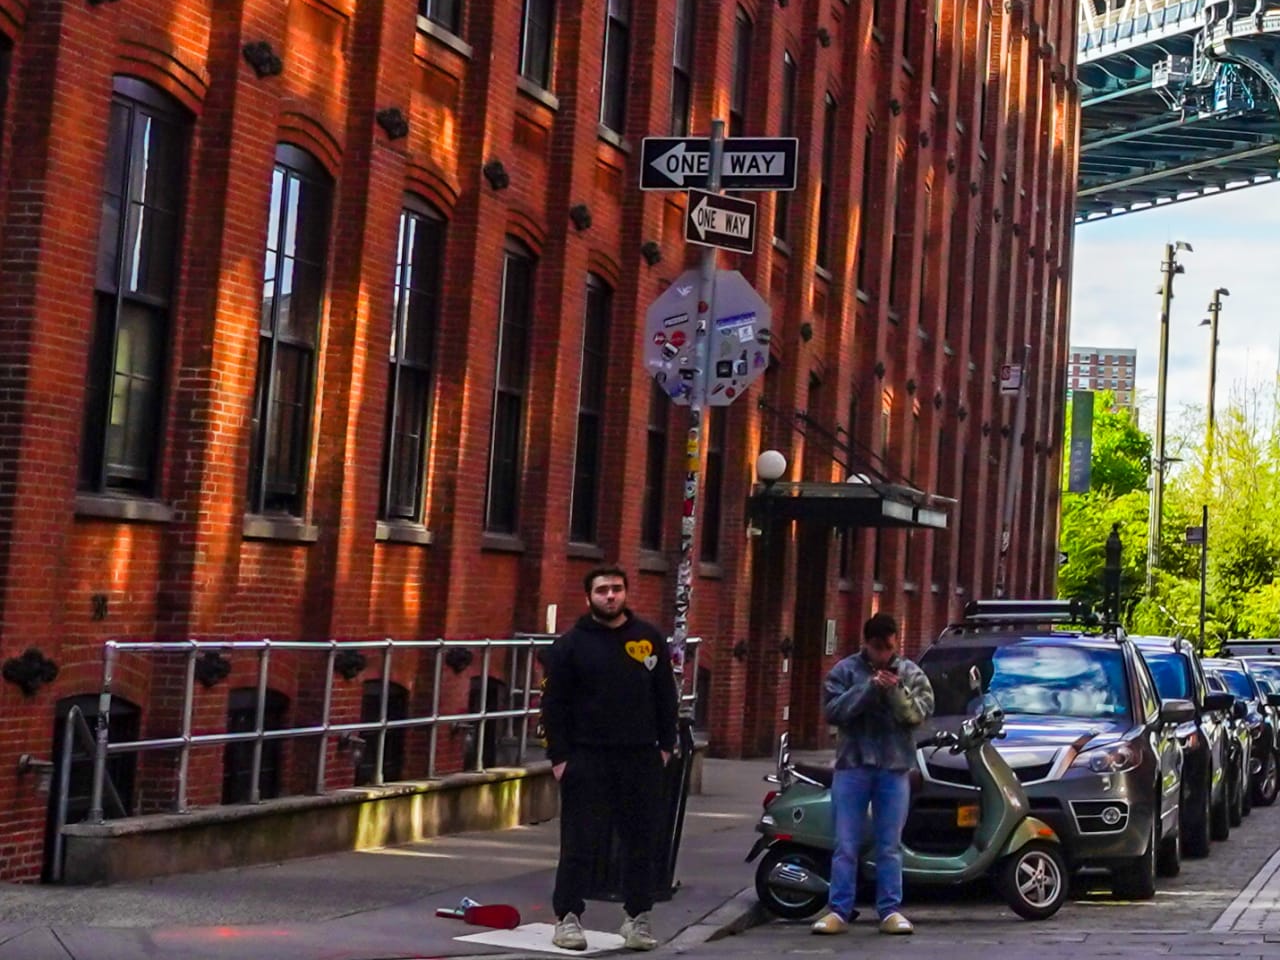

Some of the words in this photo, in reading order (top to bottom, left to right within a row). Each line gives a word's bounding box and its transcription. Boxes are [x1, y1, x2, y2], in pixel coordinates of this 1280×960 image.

[666, 155, 709, 173] ONE
[731, 155, 776, 173] WAY
[697, 211, 716, 229] ONE
[725, 215, 745, 235] WAY
